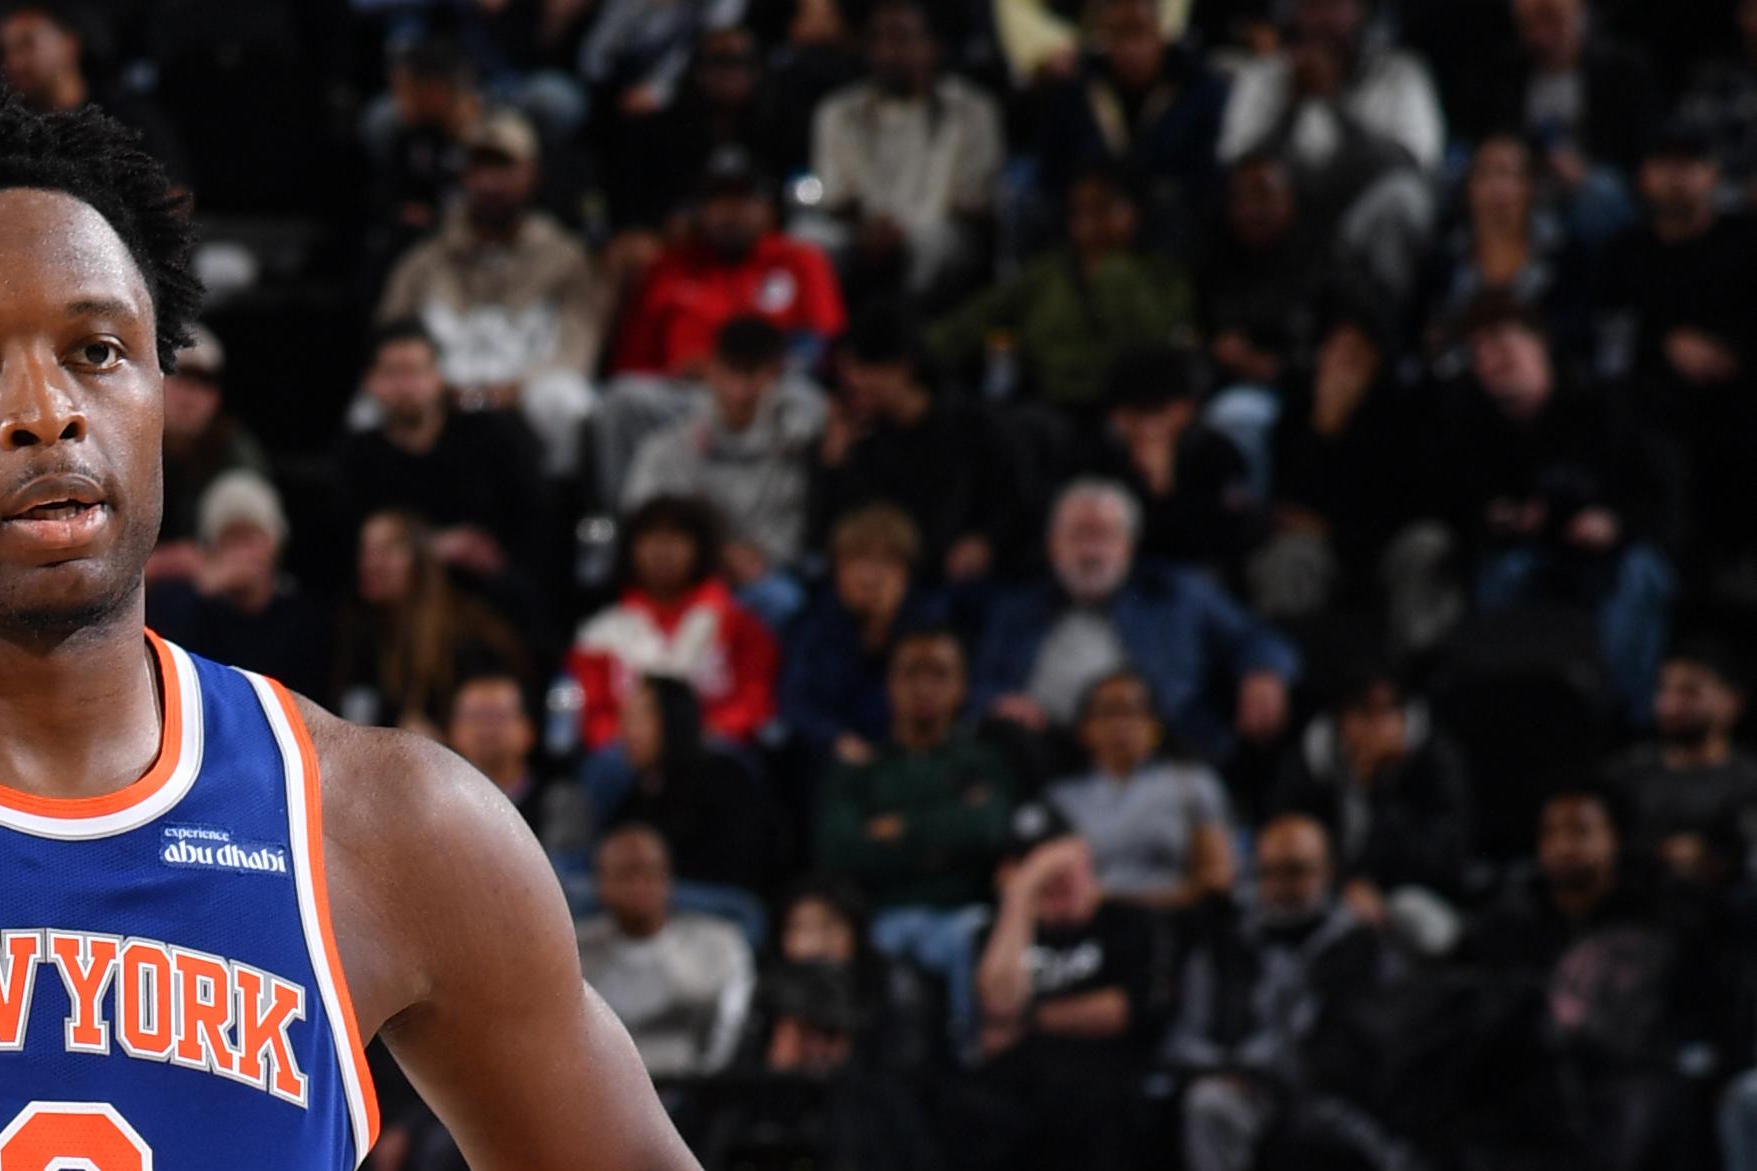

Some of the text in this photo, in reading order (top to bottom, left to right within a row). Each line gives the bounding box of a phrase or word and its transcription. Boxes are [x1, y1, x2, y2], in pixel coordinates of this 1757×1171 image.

[164, 827, 230, 842] experience
[164, 840, 286, 872] abu dhabi
[45, 928, 309, 1109] YORK
